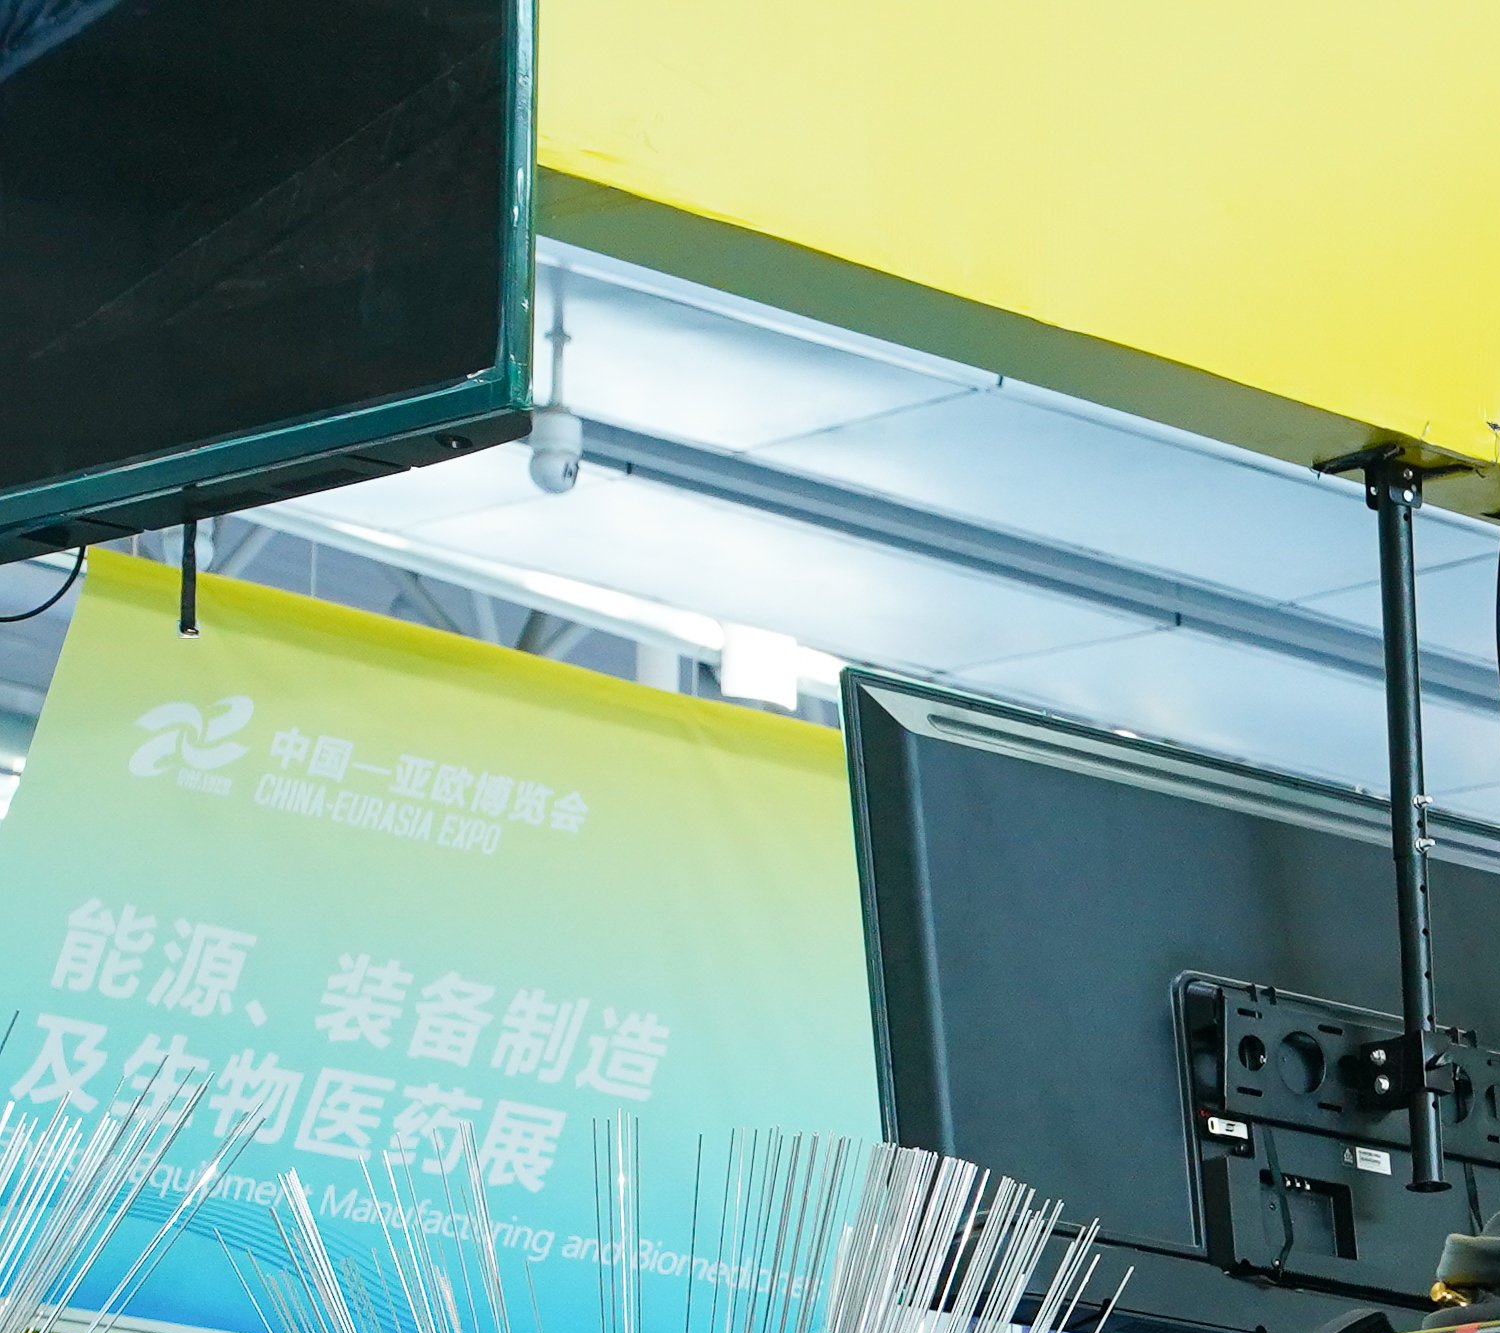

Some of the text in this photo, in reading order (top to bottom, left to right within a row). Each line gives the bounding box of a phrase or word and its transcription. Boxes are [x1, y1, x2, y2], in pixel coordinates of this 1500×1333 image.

[254, 772, 435, 842] CHINA-EURASIA
[438, 820, 502, 856] EXPO
[50, 896, 671, 1102] 能源、装备制造
[10, 1010, 568, 1194] 及生物医药展
